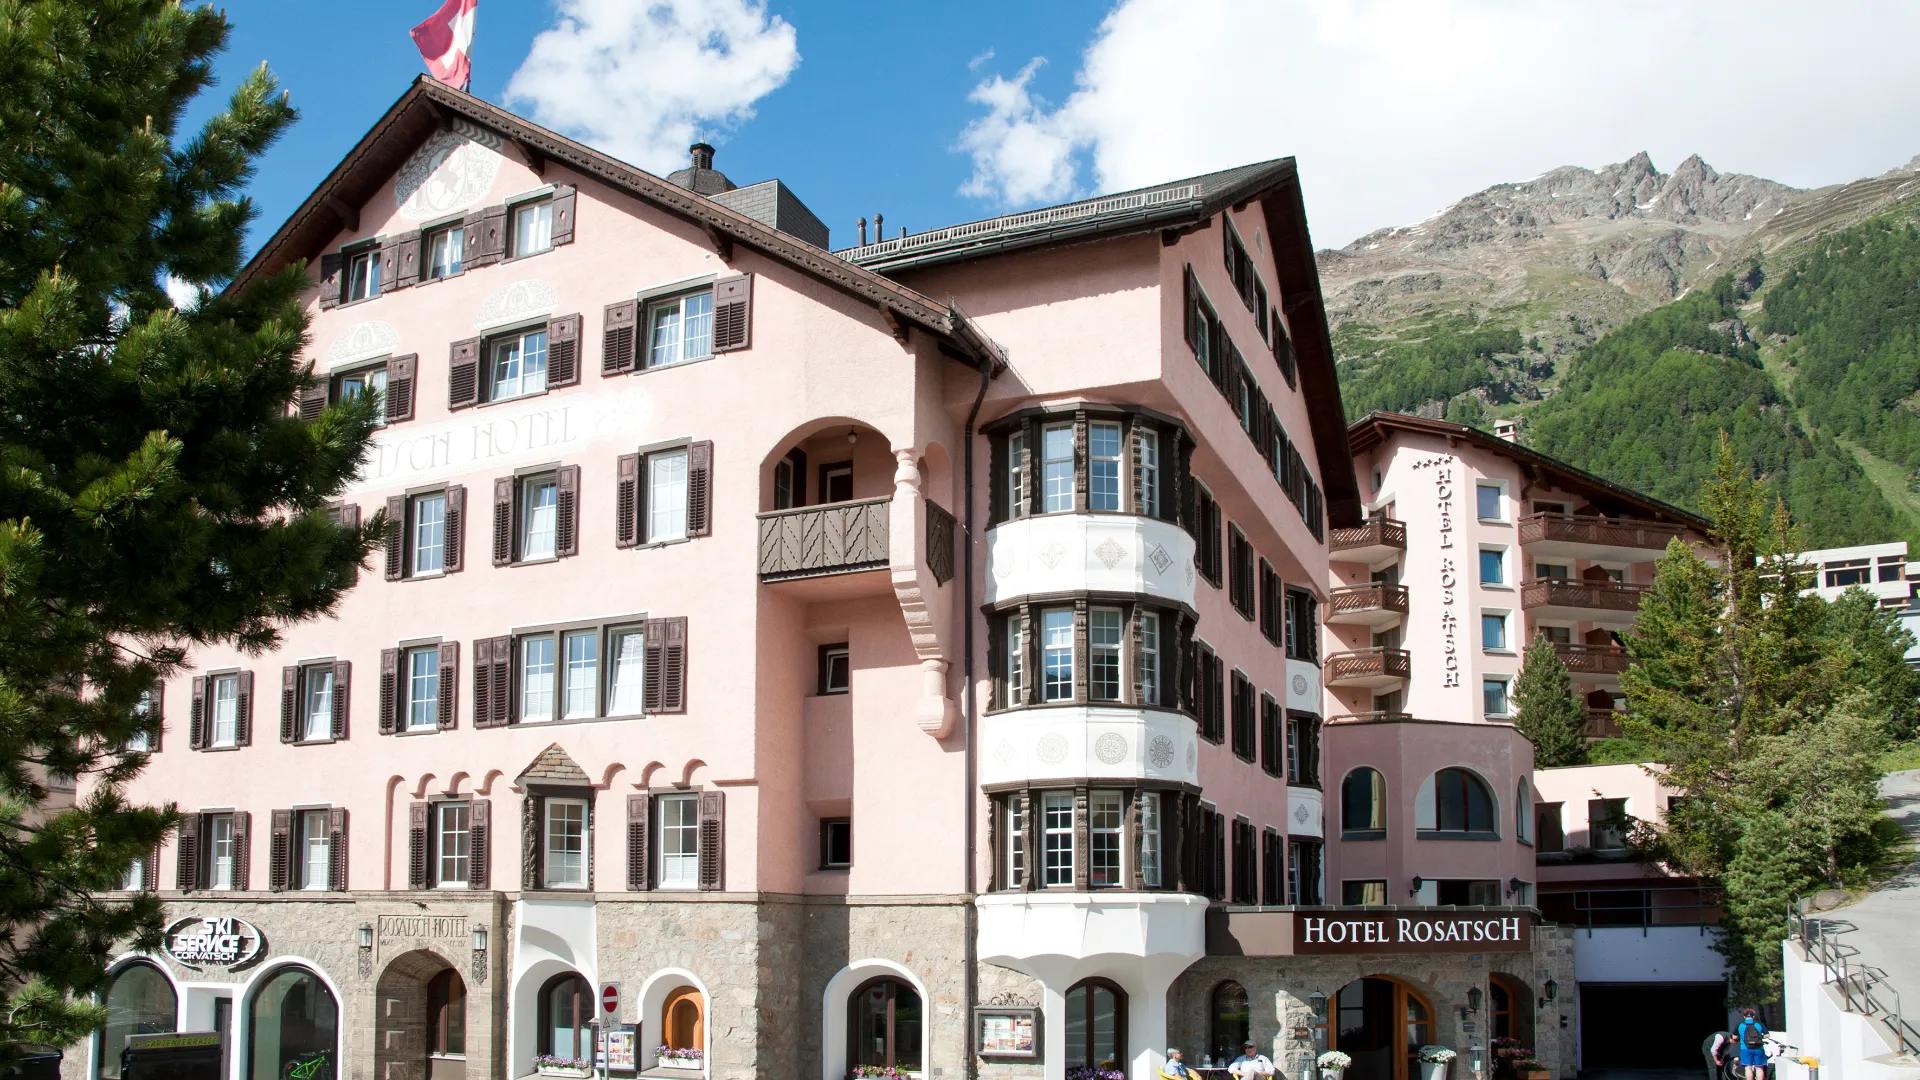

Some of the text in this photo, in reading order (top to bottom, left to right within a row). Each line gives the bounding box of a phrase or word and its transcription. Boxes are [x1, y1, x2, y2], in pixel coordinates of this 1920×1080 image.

[471, 407, 577, 461] HOTEL
[1435, 467, 1460, 688] HOTEL ROSATSCH
[197, 917, 233, 935] SKI
[1304, 917, 1521, 943] HOTEL ROSATSCH
[171, 934, 241, 953] SERVICE
[174, 952, 235, 961] CORVATSCH
[144, 1036, 218, 1049] GARTENTERRASSE
